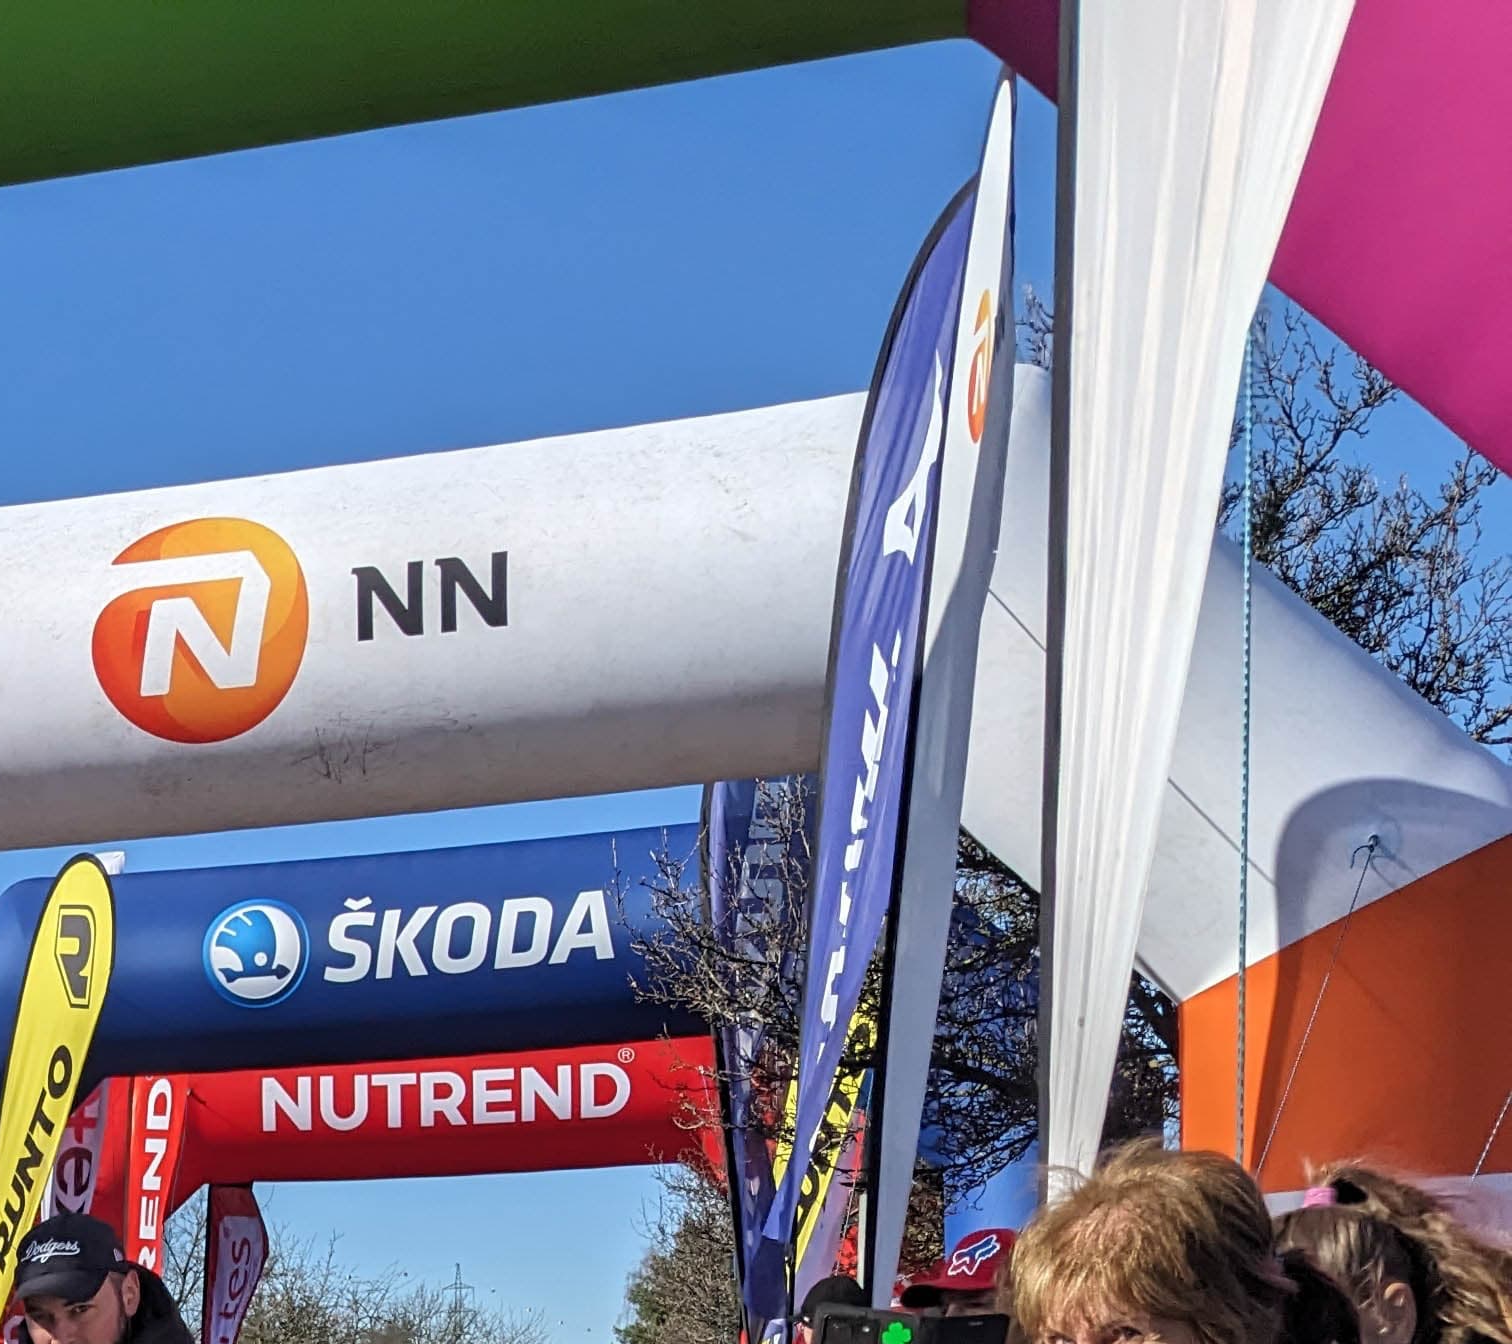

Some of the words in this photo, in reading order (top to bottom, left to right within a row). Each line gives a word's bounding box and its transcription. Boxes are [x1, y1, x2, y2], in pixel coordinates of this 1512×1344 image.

[351, 550, 508, 642] NN
[323, 889, 615, 984] ŠKODA
[21, 1237, 81, 1264] Dodgers
